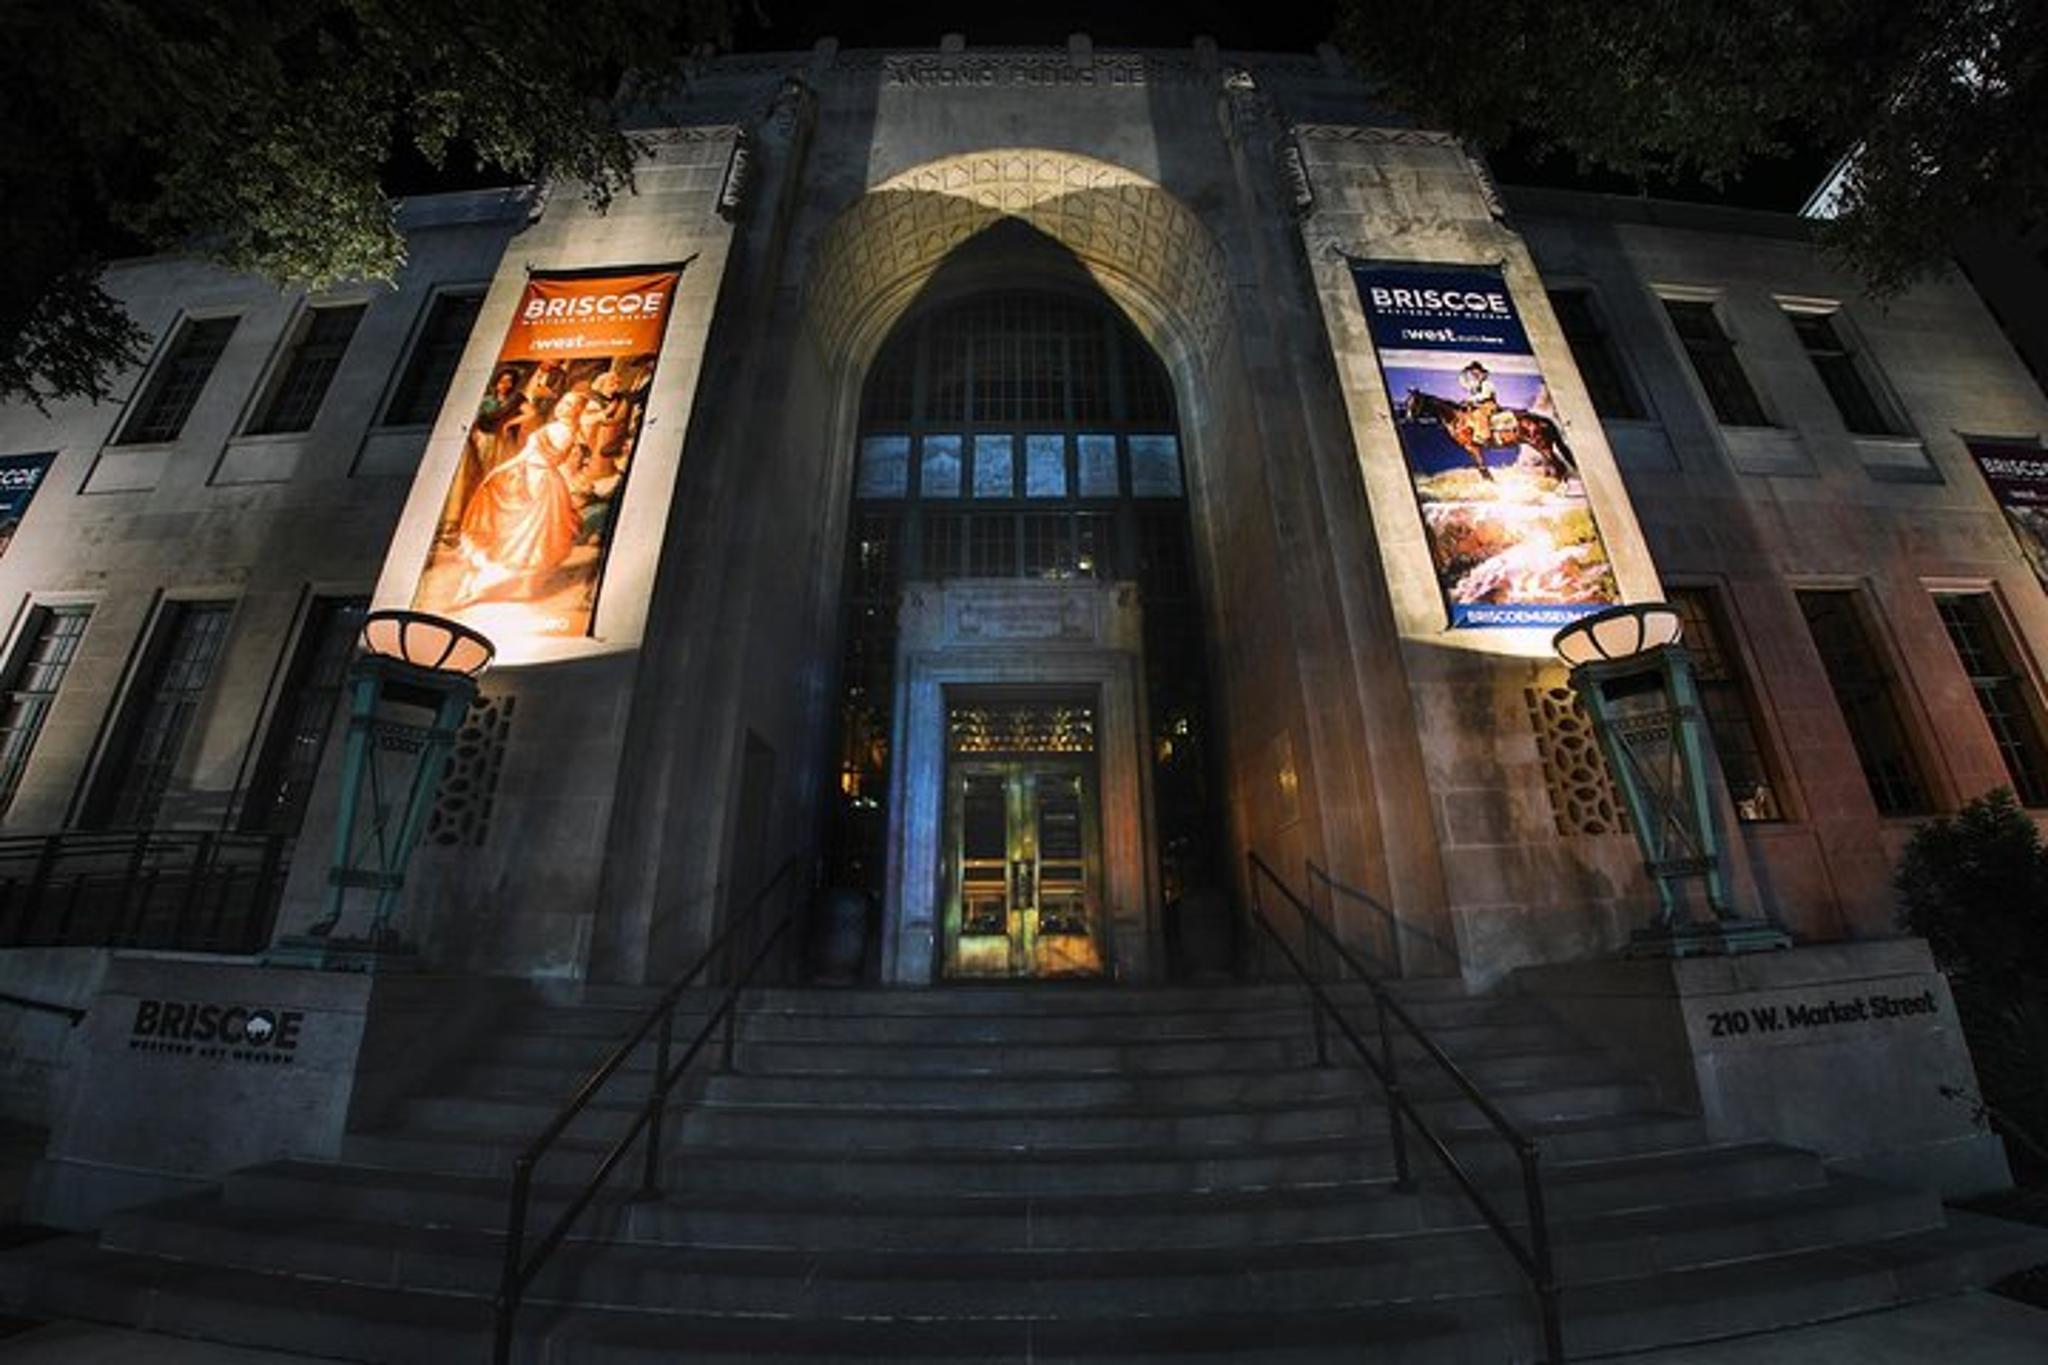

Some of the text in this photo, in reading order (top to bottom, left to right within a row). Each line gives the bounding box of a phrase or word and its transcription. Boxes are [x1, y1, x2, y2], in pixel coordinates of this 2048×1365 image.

[524, 293, 663, 319] BRISCOE
[1370, 287, 1508, 313] BRISCOE
[134, 1000, 304, 1049] BRISCOE
[1707, 990, 1938, 1037] 210 W. Market Street
